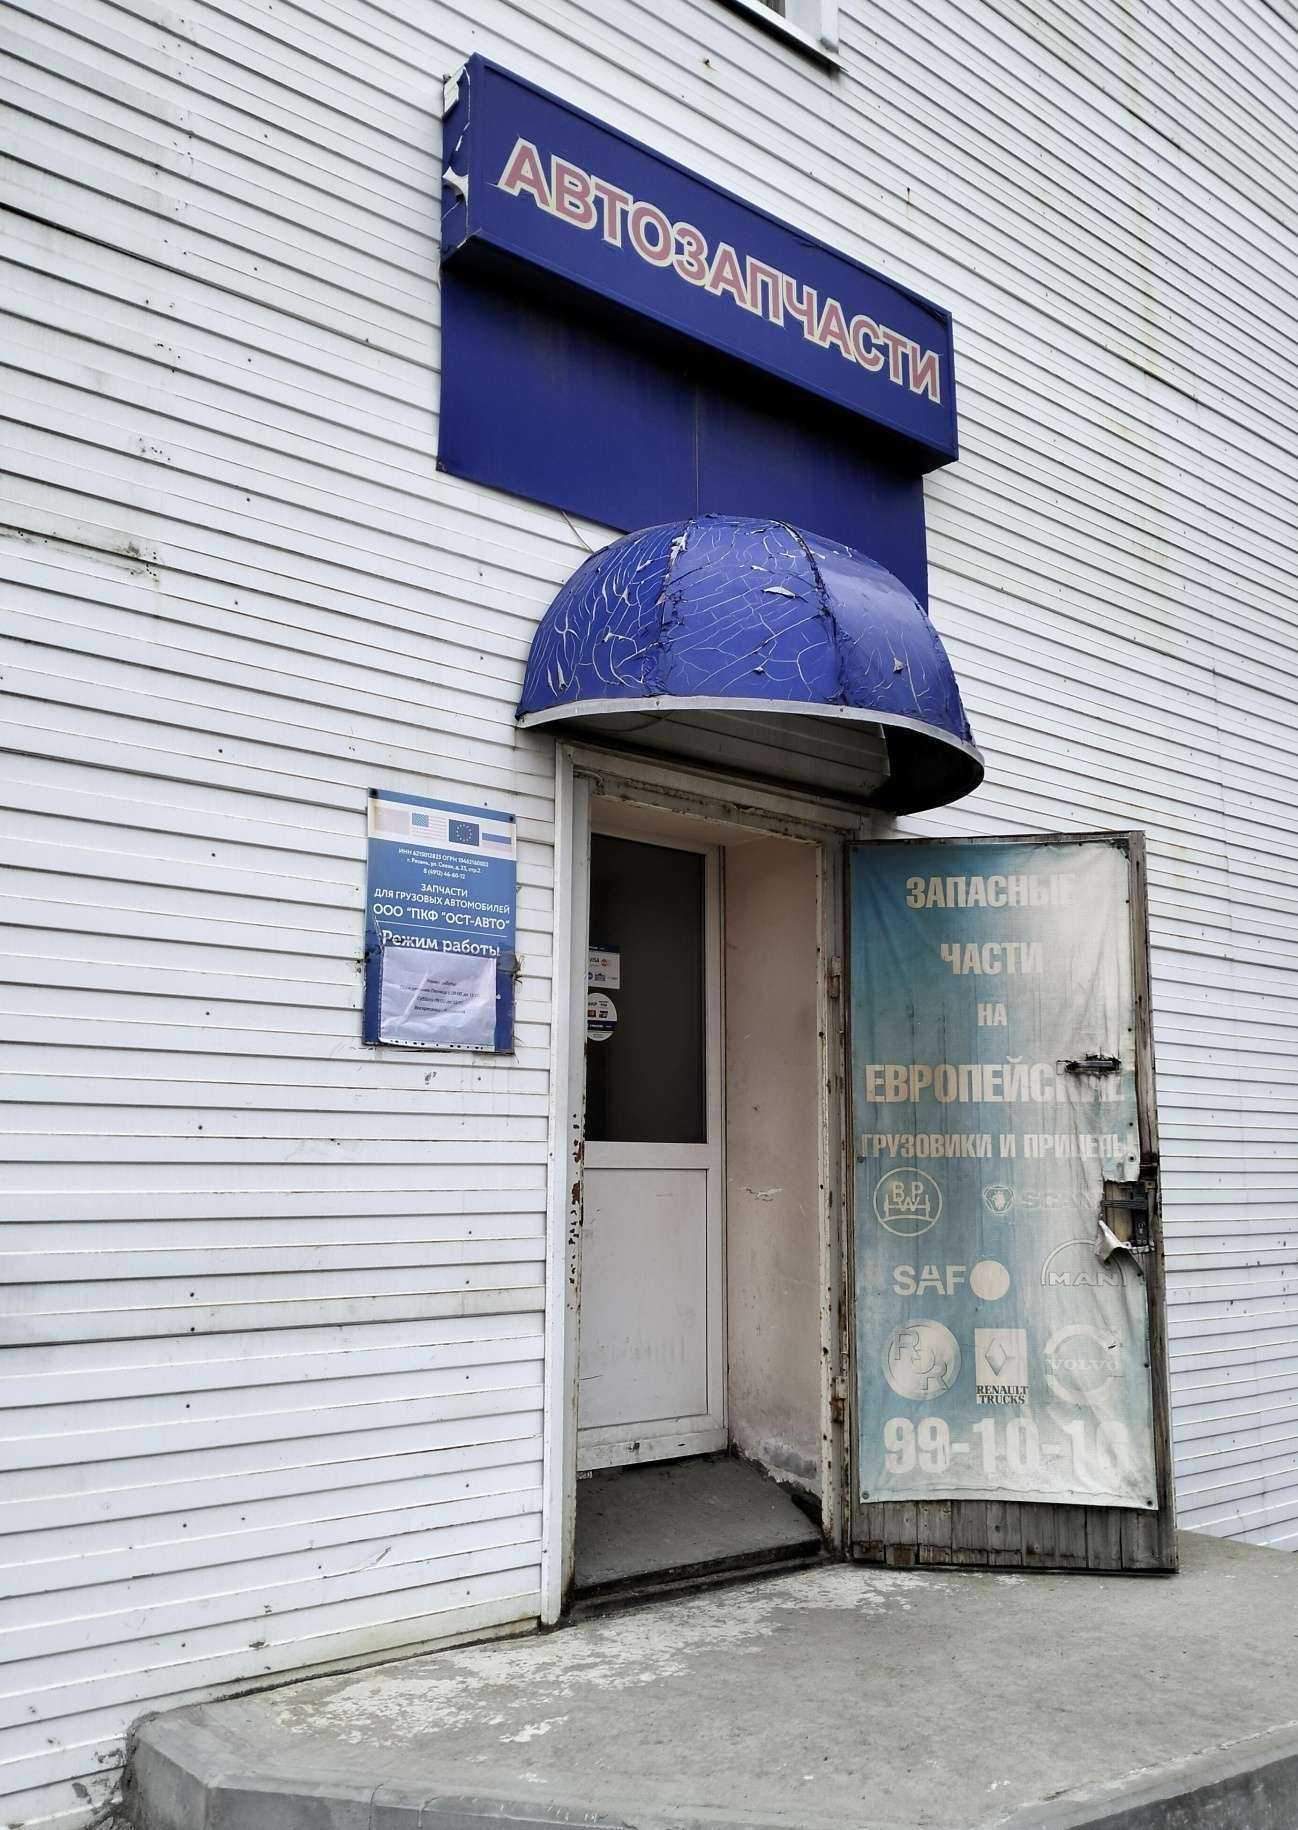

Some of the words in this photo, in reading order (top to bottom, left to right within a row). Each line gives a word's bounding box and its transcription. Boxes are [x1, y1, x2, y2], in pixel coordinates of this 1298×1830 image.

[497, 136, 942, 404] АВТОЗАПЧАСТИ
[374, 888, 395, 899] ДЛЯ
[395, 891, 443, 905] ГРУЗОВЫХ
[444, 898, 511, 915] АВТОМОБИЛЕЙ
[420, 883, 469, 898] ЗАПЧАСТИ
[904, 873, 1077, 909] ЗАПАСНЫЕ
[373, 903, 404, 917] ООО
[381, 929, 439, 950] Режим
[442, 939, 501, 957] работы
[940, 942, 1044, 976] ЧАСТИ
[977, 1003, 1008, 1026] НА
[861, 1133, 992, 1159] ГРУЗОВИКИ
[999, 1133, 1016, 1158] И
[893, 1264, 969, 1297] SAF
[1050, 1271, 1120, 1287] MAN
[1048, 1357, 1120, 1372] VOLVO
[976, 1385, 1029, 1395] RENAULT
[978, 1395, 1026, 1405] TRUCKS
